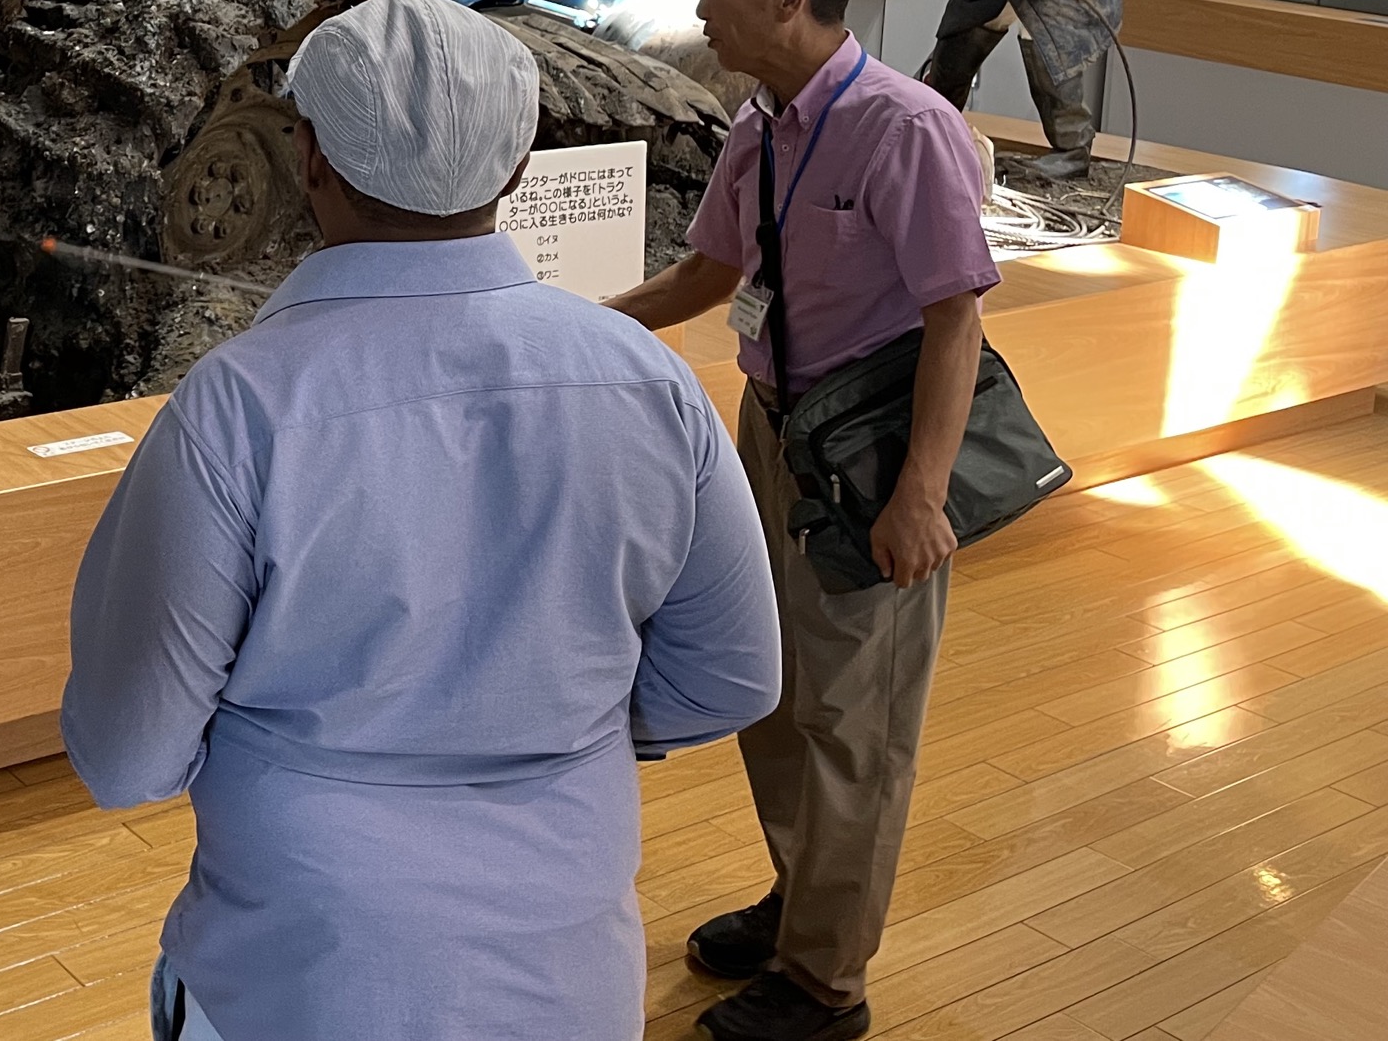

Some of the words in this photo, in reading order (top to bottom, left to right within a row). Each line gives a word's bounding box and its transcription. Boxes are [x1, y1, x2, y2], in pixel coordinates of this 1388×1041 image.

[520, 166, 634, 189] ラクターがドロにはまって
